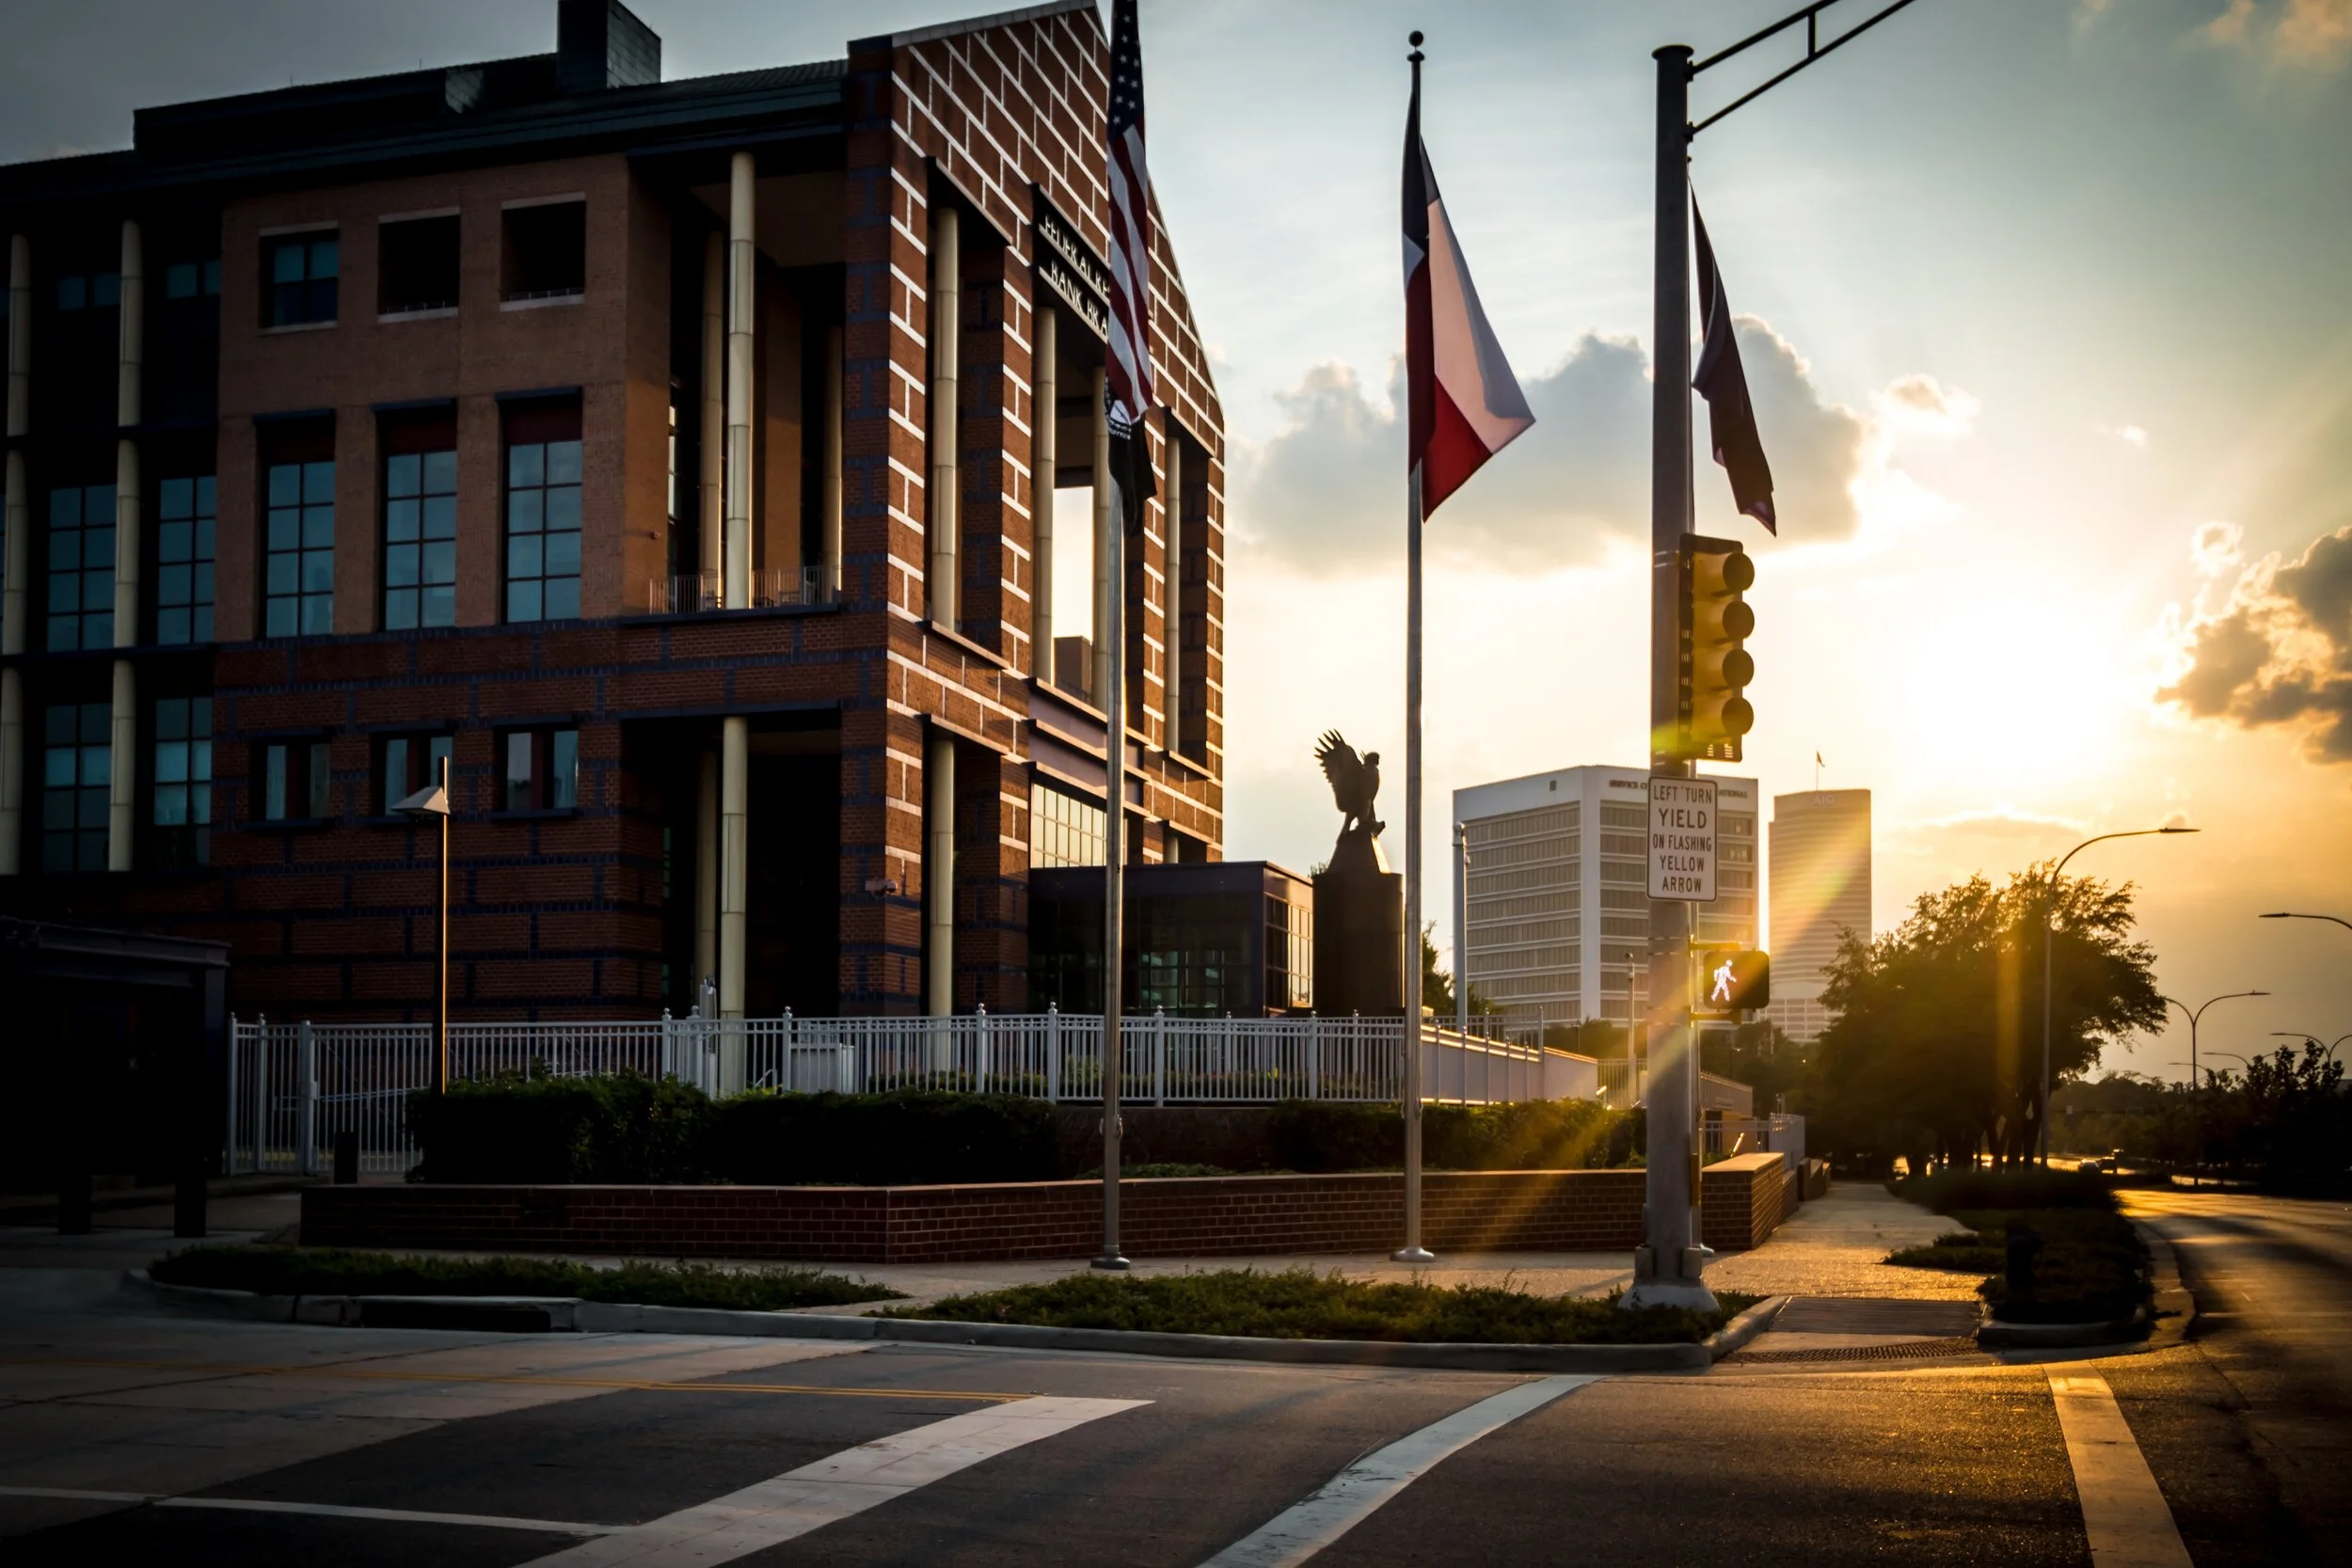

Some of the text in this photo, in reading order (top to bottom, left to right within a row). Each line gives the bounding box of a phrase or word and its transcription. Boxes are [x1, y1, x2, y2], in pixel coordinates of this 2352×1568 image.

[1052, 260, 1083, 312] BANK
[1653, 785, 1712, 804] LEFT TURN
[1659, 808, 1707, 829] YIELD
[1653, 833, 1712, 852] ON FLASHING
[1660, 855, 1705, 873] YELLOW
[1661, 877, 1702, 893] ARROW
